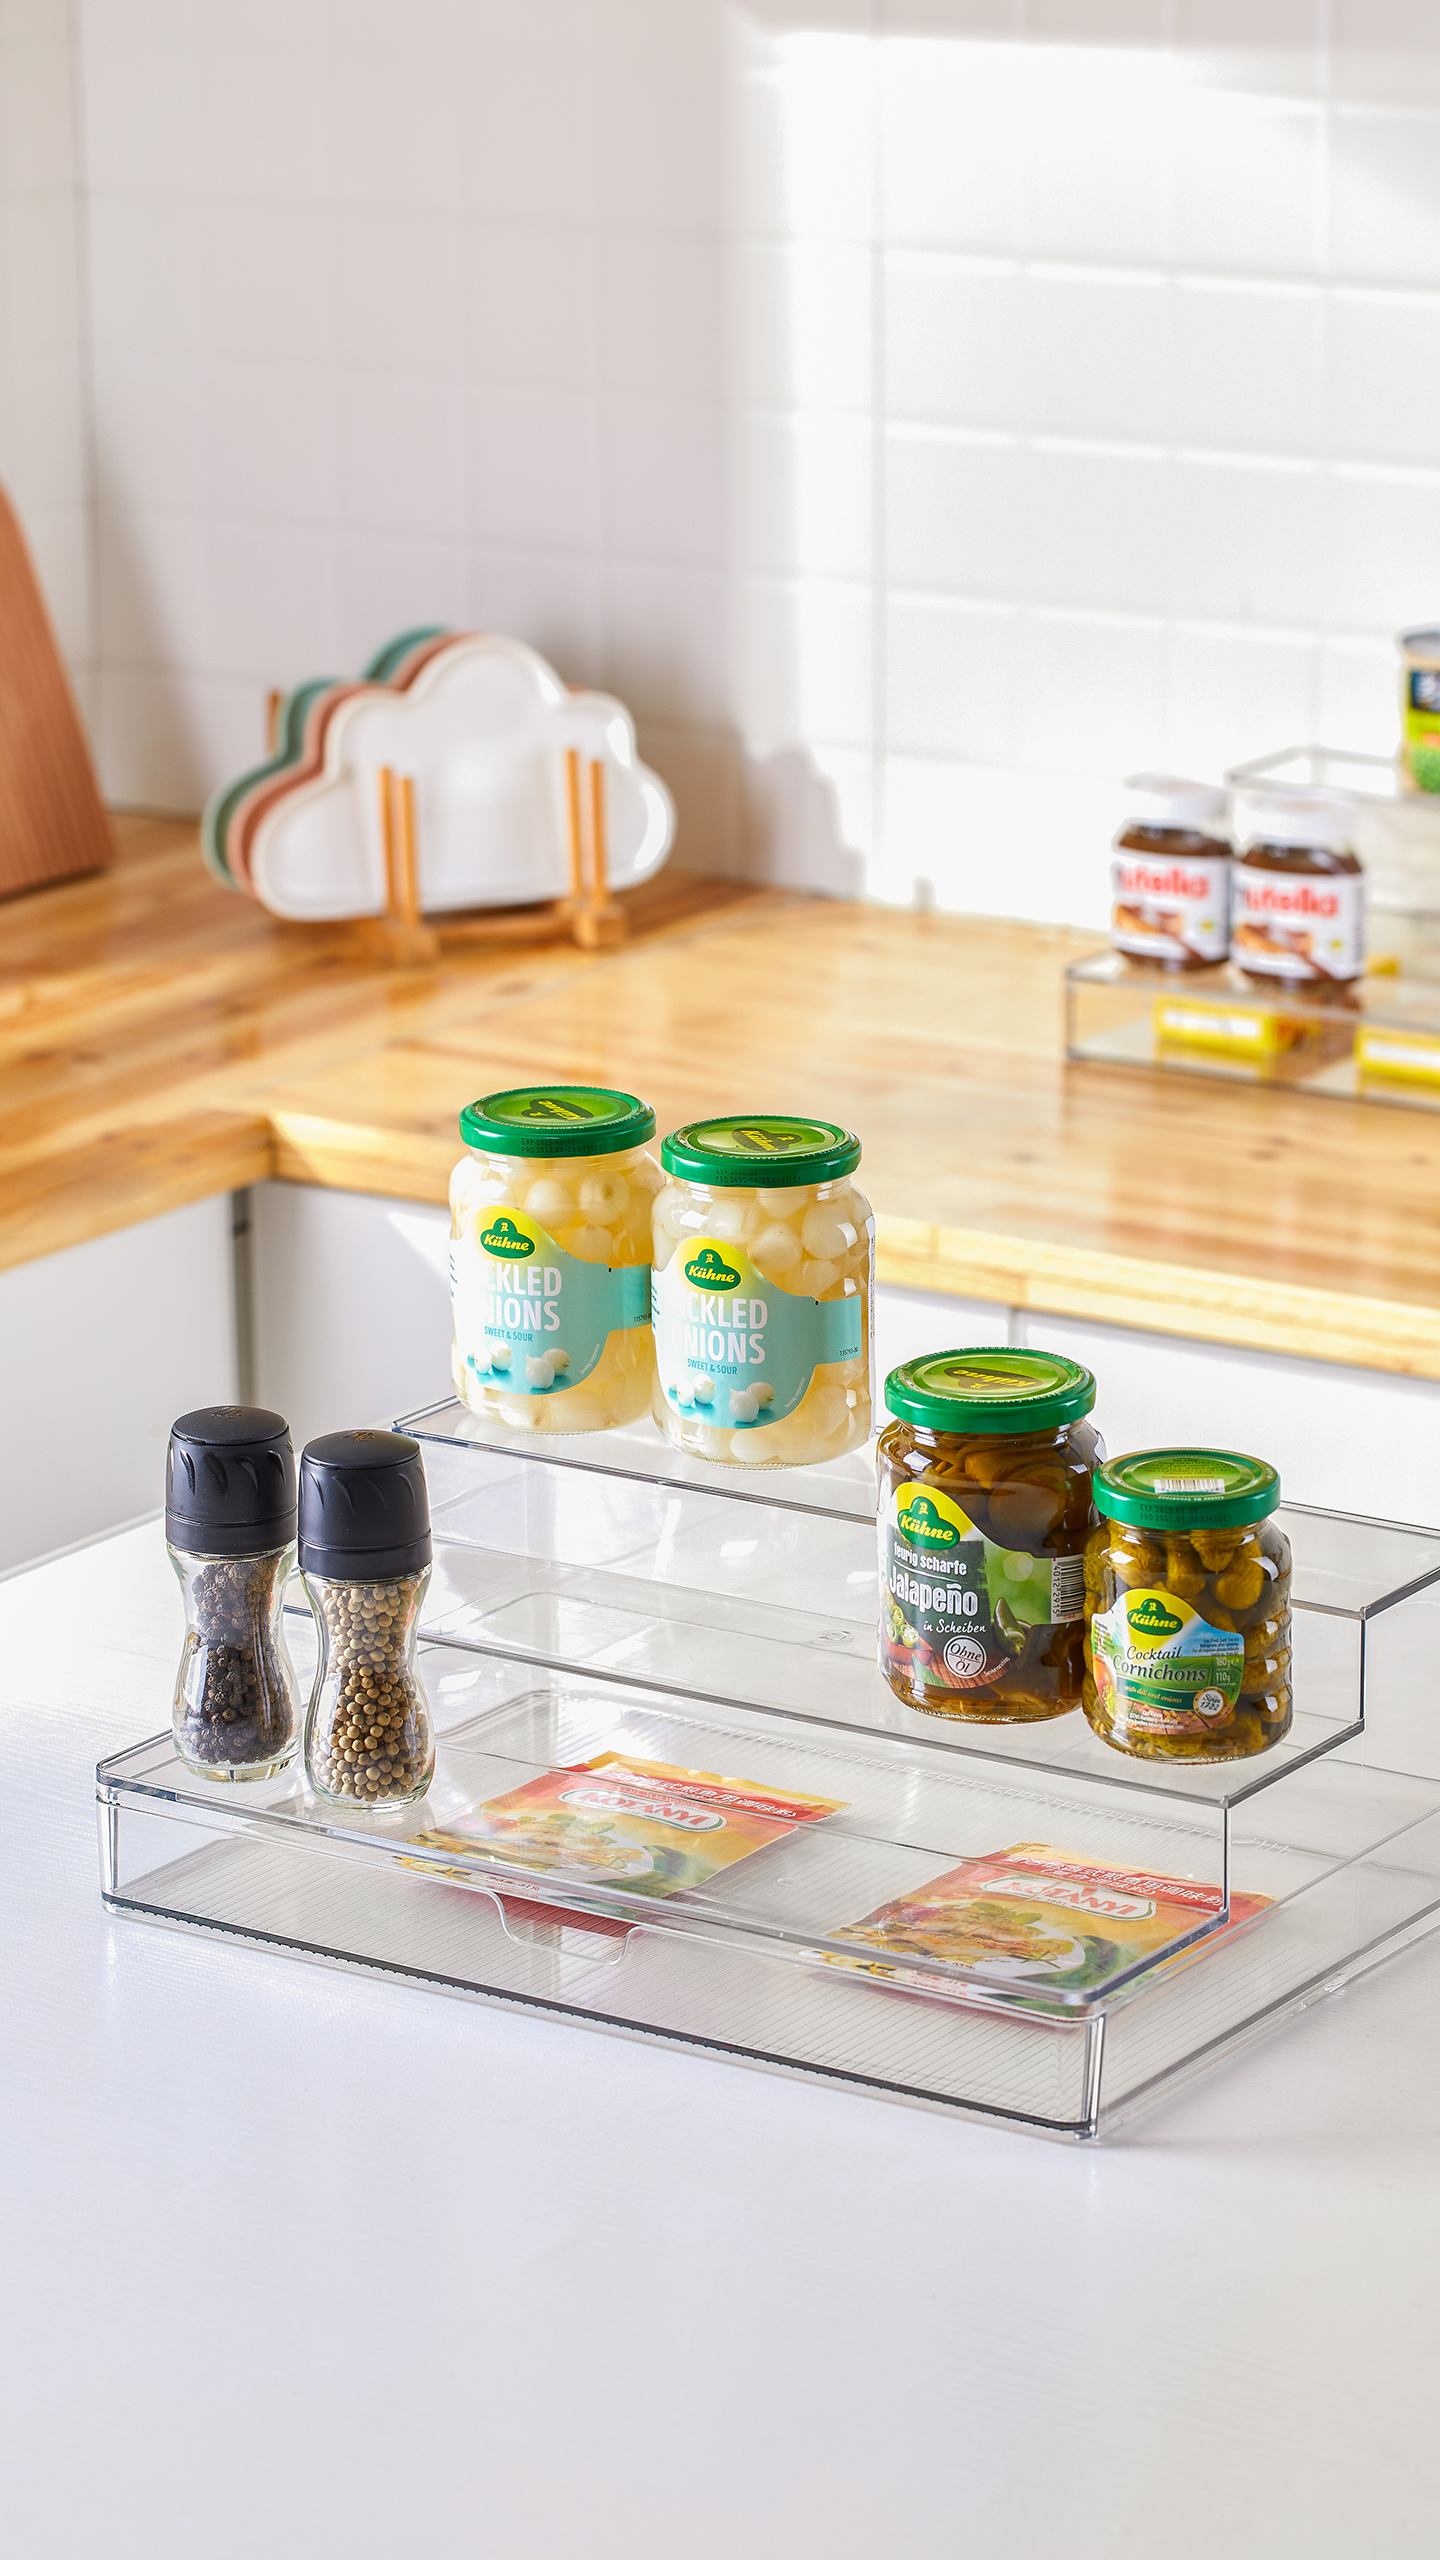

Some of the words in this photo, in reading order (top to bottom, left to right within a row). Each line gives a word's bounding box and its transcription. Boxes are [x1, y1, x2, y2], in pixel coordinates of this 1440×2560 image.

[484, 1233, 530, 1251] Kühne
[481, 1259, 562, 1297] CKLED
[688, 1265, 736, 1284] Kühne
[484, 1325, 506, 1339] SWEET
[506, 1331, 512, 1340] &
[513, 1332, 534, 1342] SOUR
[687, 1358, 710, 1371] SWEET
[710, 1363, 716, 1373] &
[717, 1364, 738, 1375] SOUR
[1139, 1503, 1153, 1512] EXP
[900, 1514, 954, 1541] Kühne
[894, 1541, 918, 1567] feurig
[919, 1555, 967, 1576] scharfe
[1053, 1565, 1061, 1588] 4012
[889, 1565, 979, 1617] Jalapeño
[923, 1621, 935, 1631] in
[936, 1619, 987, 1634] Scheiben
[1129, 1612, 1178, 1629] Kühne
[950, 1643, 982, 1661] Ohne
[1127, 1645, 1183, 1660] Cocktail
[955, 1658, 970, 1674] Öl
[1113, 1655, 1207, 1682] Cornichons
[1125, 1685, 1137, 1693] with
[1137, 1688, 1148, 1696] dill
[1161, 1695, 1183, 1703] onions
[1202, 1693, 1221, 1703] Since
[1200, 1701, 1220, 1711] 1722
